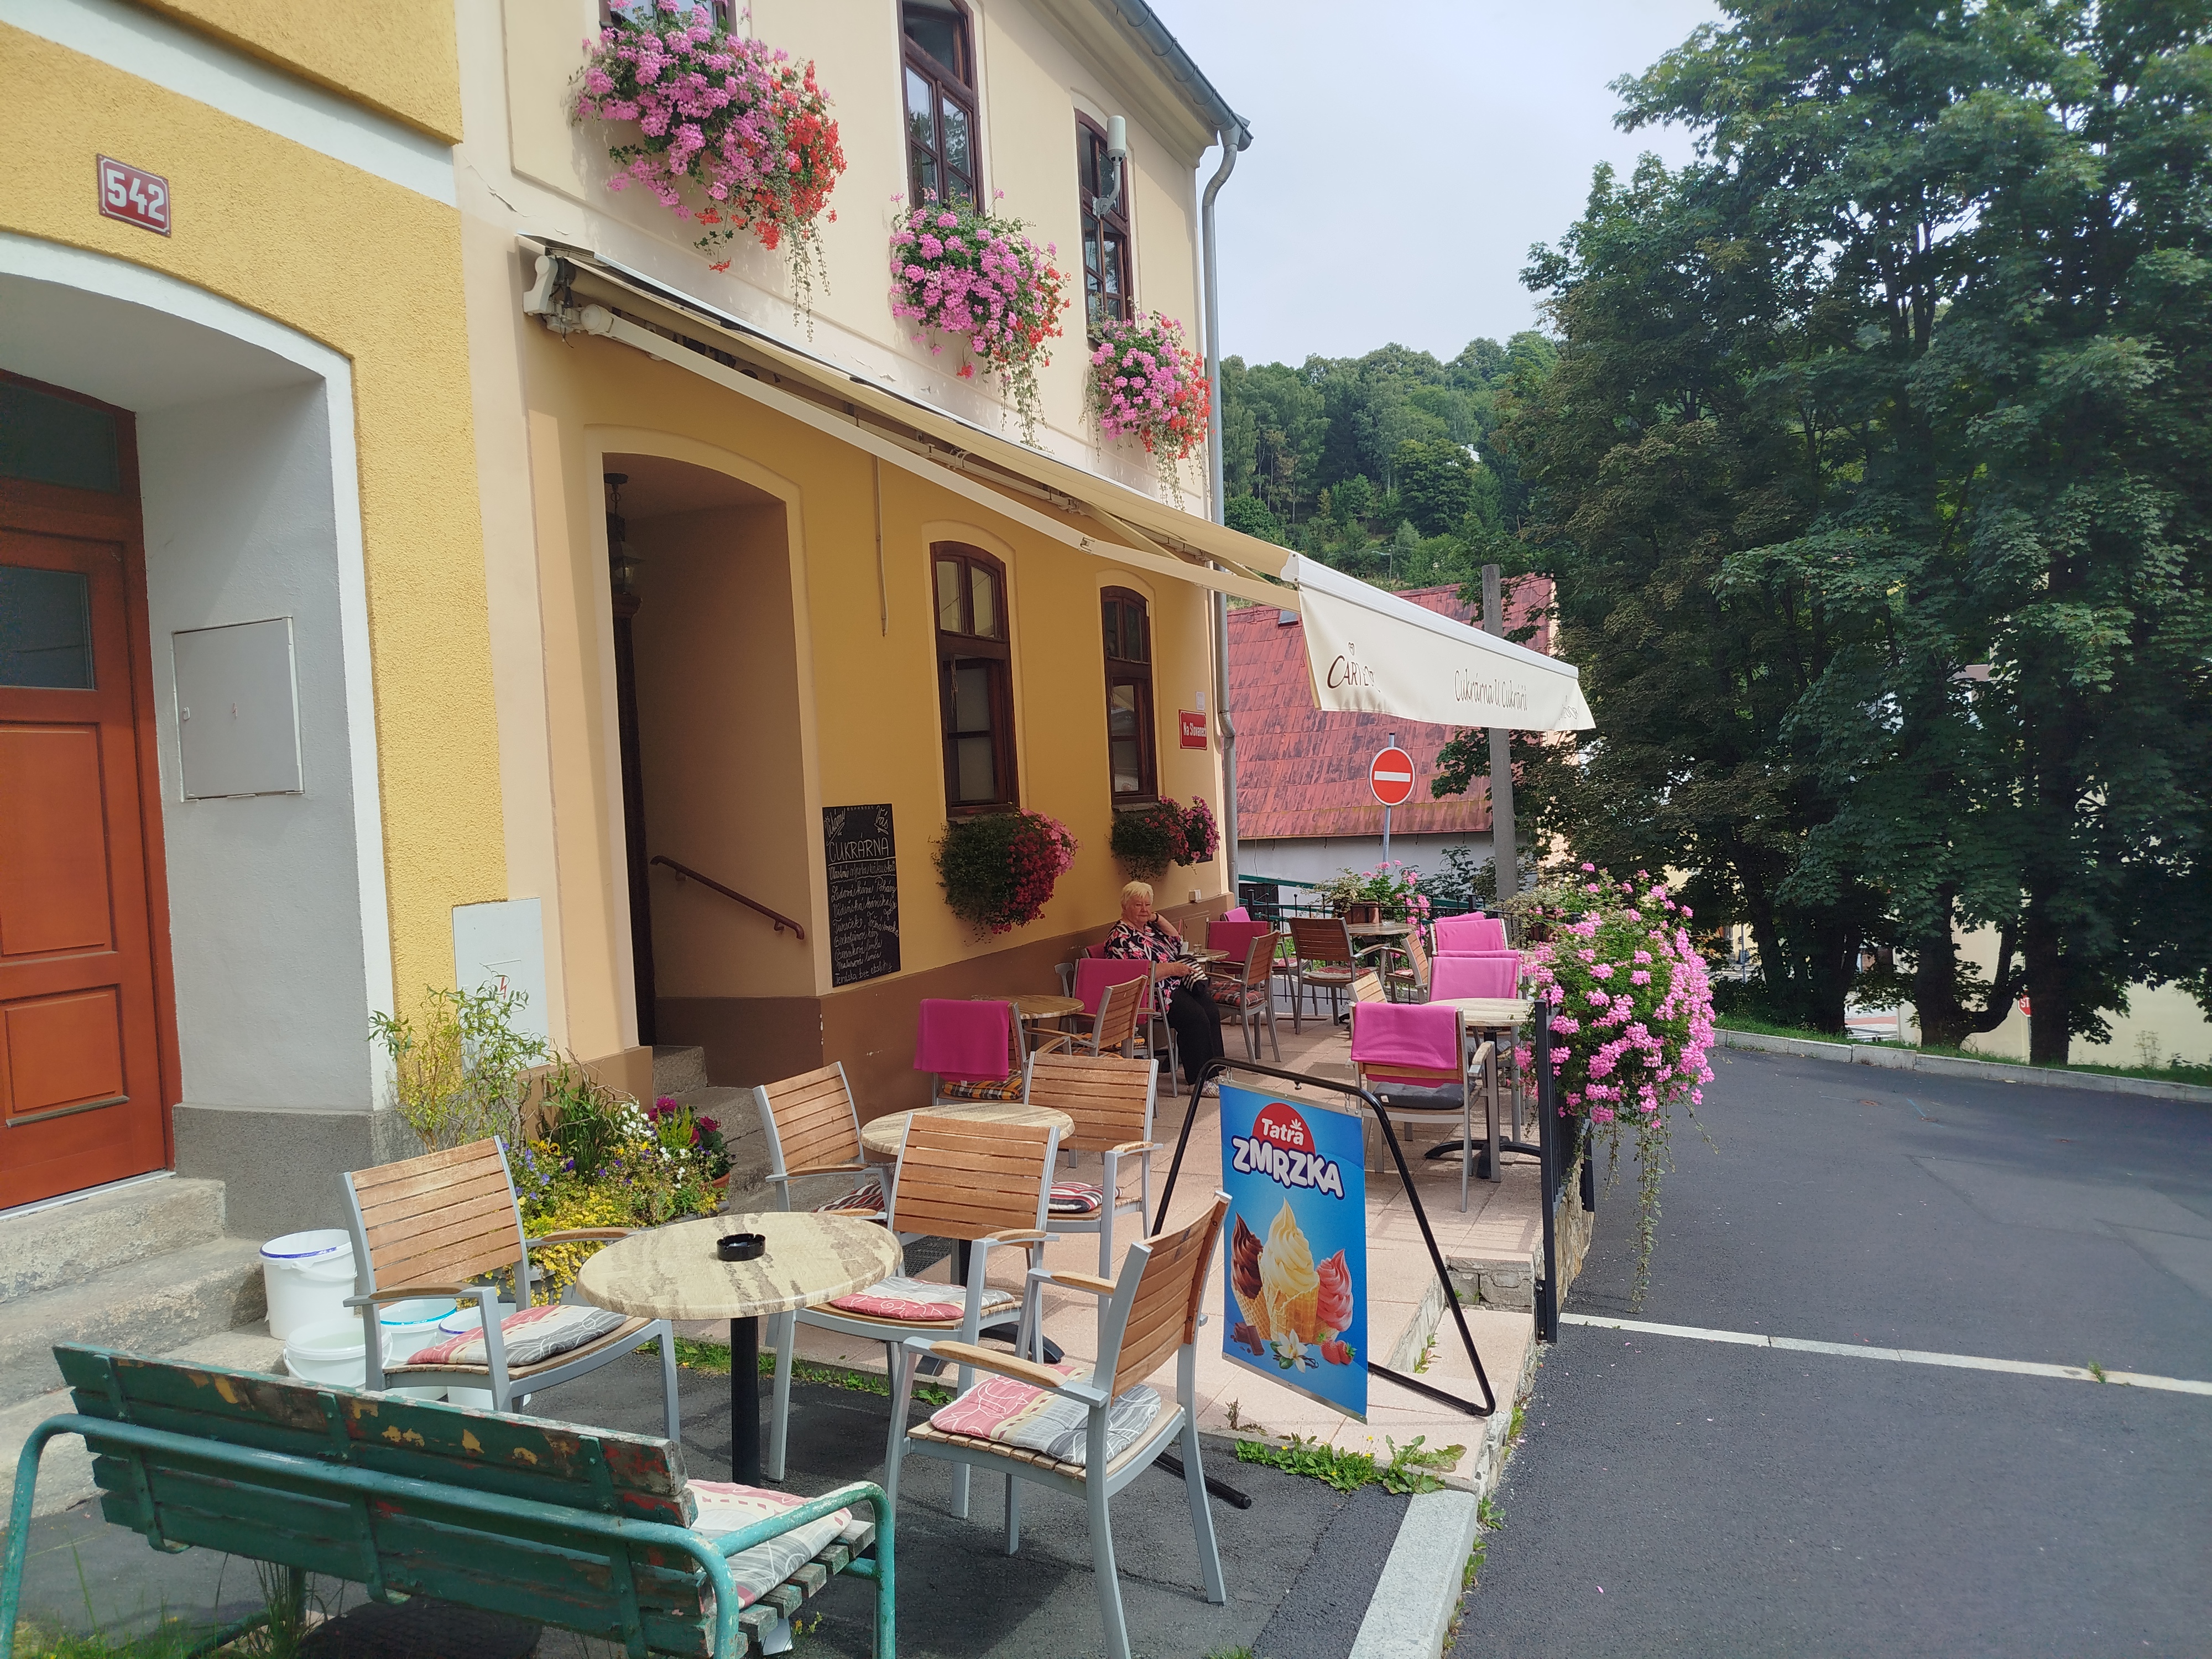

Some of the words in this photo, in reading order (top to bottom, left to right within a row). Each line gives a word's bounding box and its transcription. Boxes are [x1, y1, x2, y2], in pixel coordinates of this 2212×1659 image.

[107, 168, 165, 222] 542
[1455, 668, 1494, 705] Cukrárna
[1183, 722, 1189, 736] Na
[1190, 722, 1207, 737] Slovanech
[829, 832, 889, 863] CUKRÁRNA
[1261, 1118, 1304, 1146] Tatra
[1232, 1137, 1344, 1199] ZMRZKA
